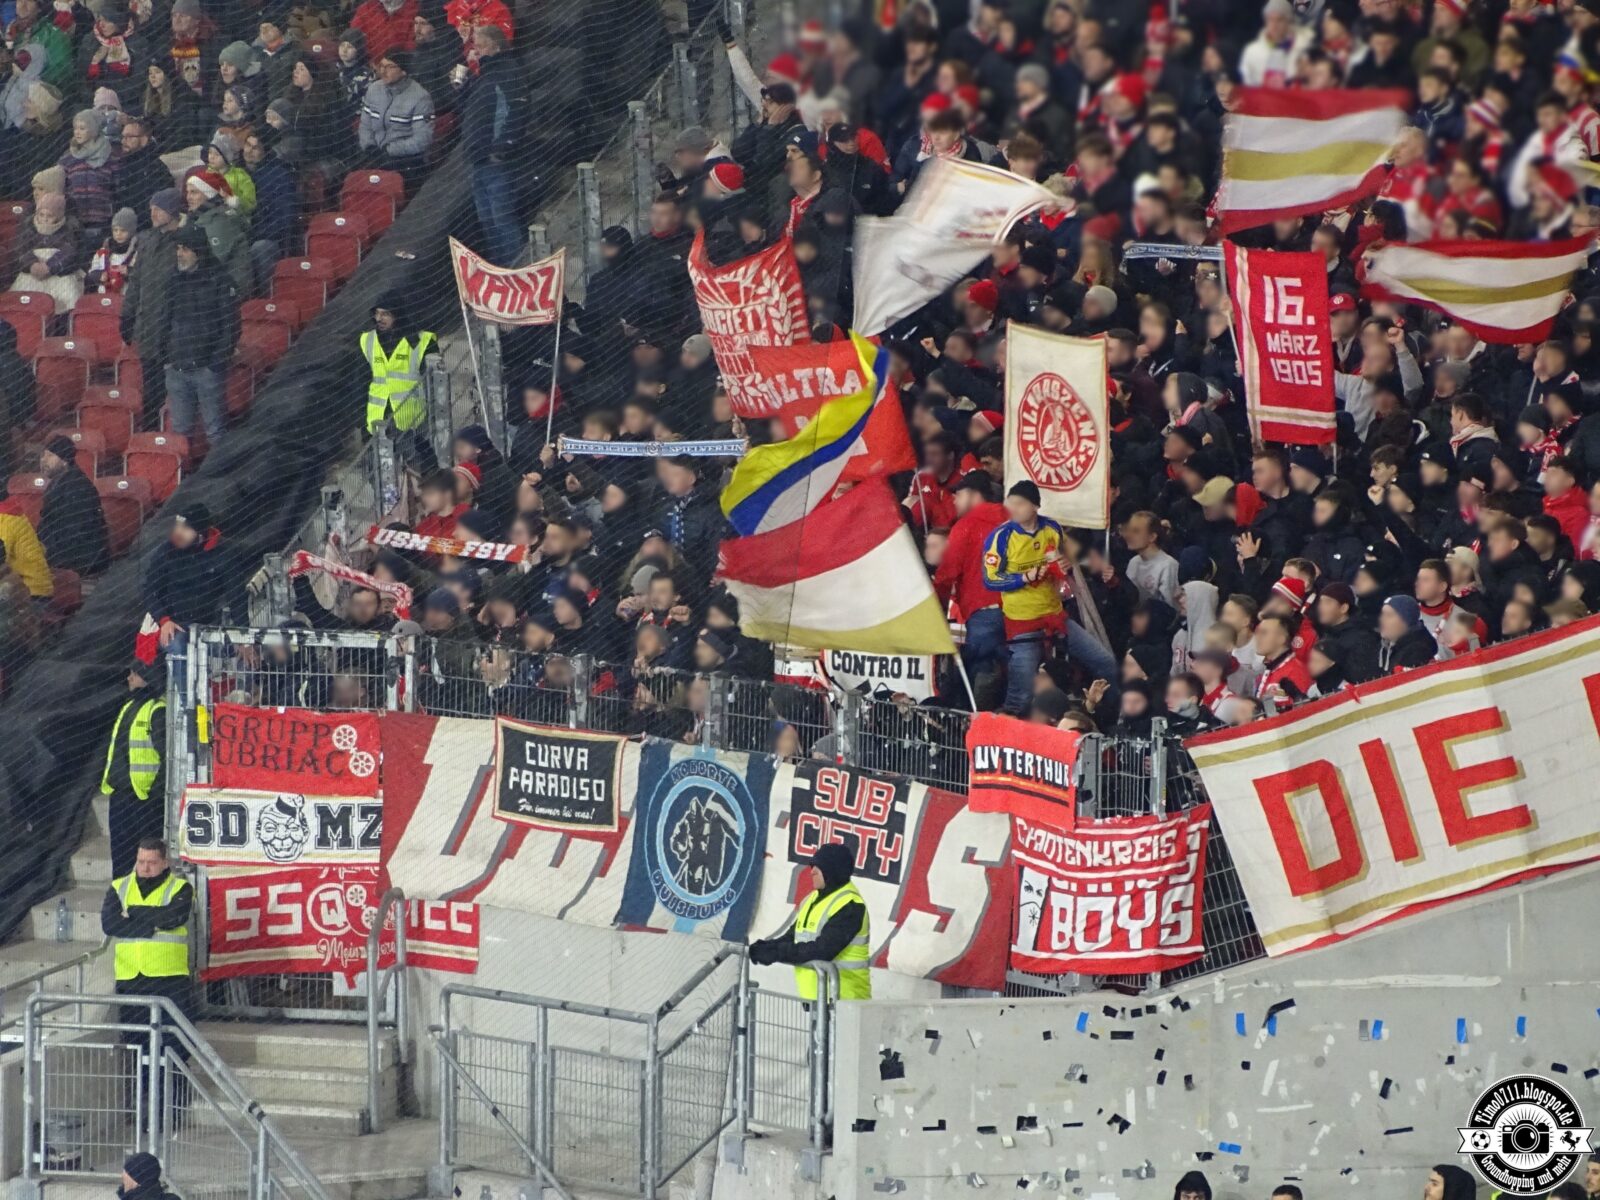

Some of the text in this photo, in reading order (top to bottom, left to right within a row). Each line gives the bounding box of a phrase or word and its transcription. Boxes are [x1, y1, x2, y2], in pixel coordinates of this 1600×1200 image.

[460, 256, 556, 314] MAINZ
[1262, 275, 1315, 326] 16.
[1265, 330, 1321, 356] MÄRZ
[1269, 357, 1323, 387] 1905
[373, 528, 516, 561] USM FSV
[831, 650, 925, 681] CONTRO IL
[525, 740, 589, 771] CURVA
[508, 766, 606, 802] PARADISO
[814, 767, 896, 825] SUB
[1252, 706, 1539, 901] DIE
[186, 801, 383, 851] SD MZ
